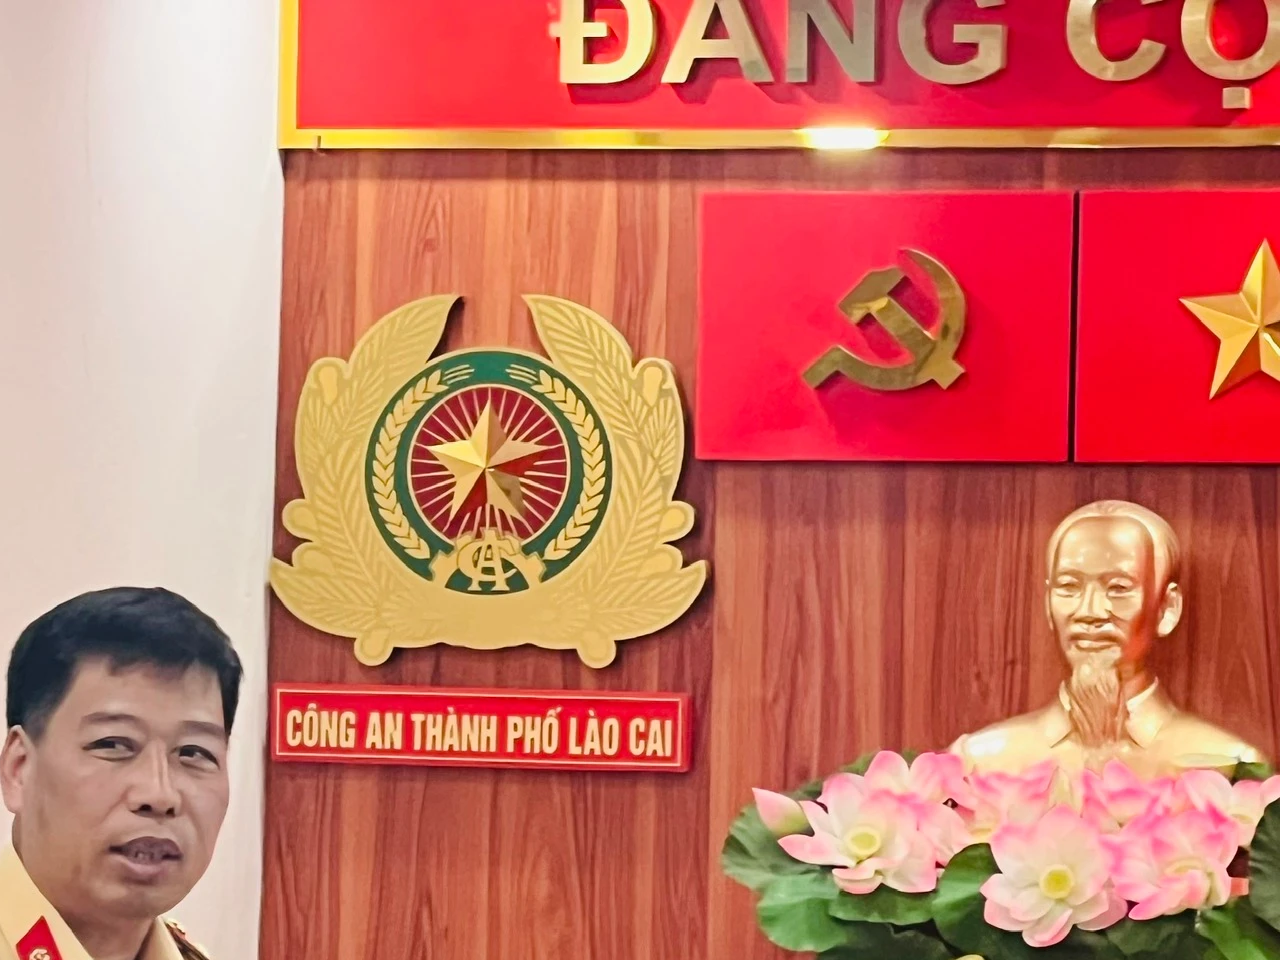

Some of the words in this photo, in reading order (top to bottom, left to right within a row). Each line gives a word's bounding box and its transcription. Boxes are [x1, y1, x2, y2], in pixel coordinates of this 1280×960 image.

[286, 703, 356, 748] CÔNG
[365, 711, 403, 750] AN
[411, 706, 497, 753] THÀNH
[506, 706, 563, 754] PHỐ
[568, 708, 619, 756] LÀO
[628, 718, 673, 757] CAI
